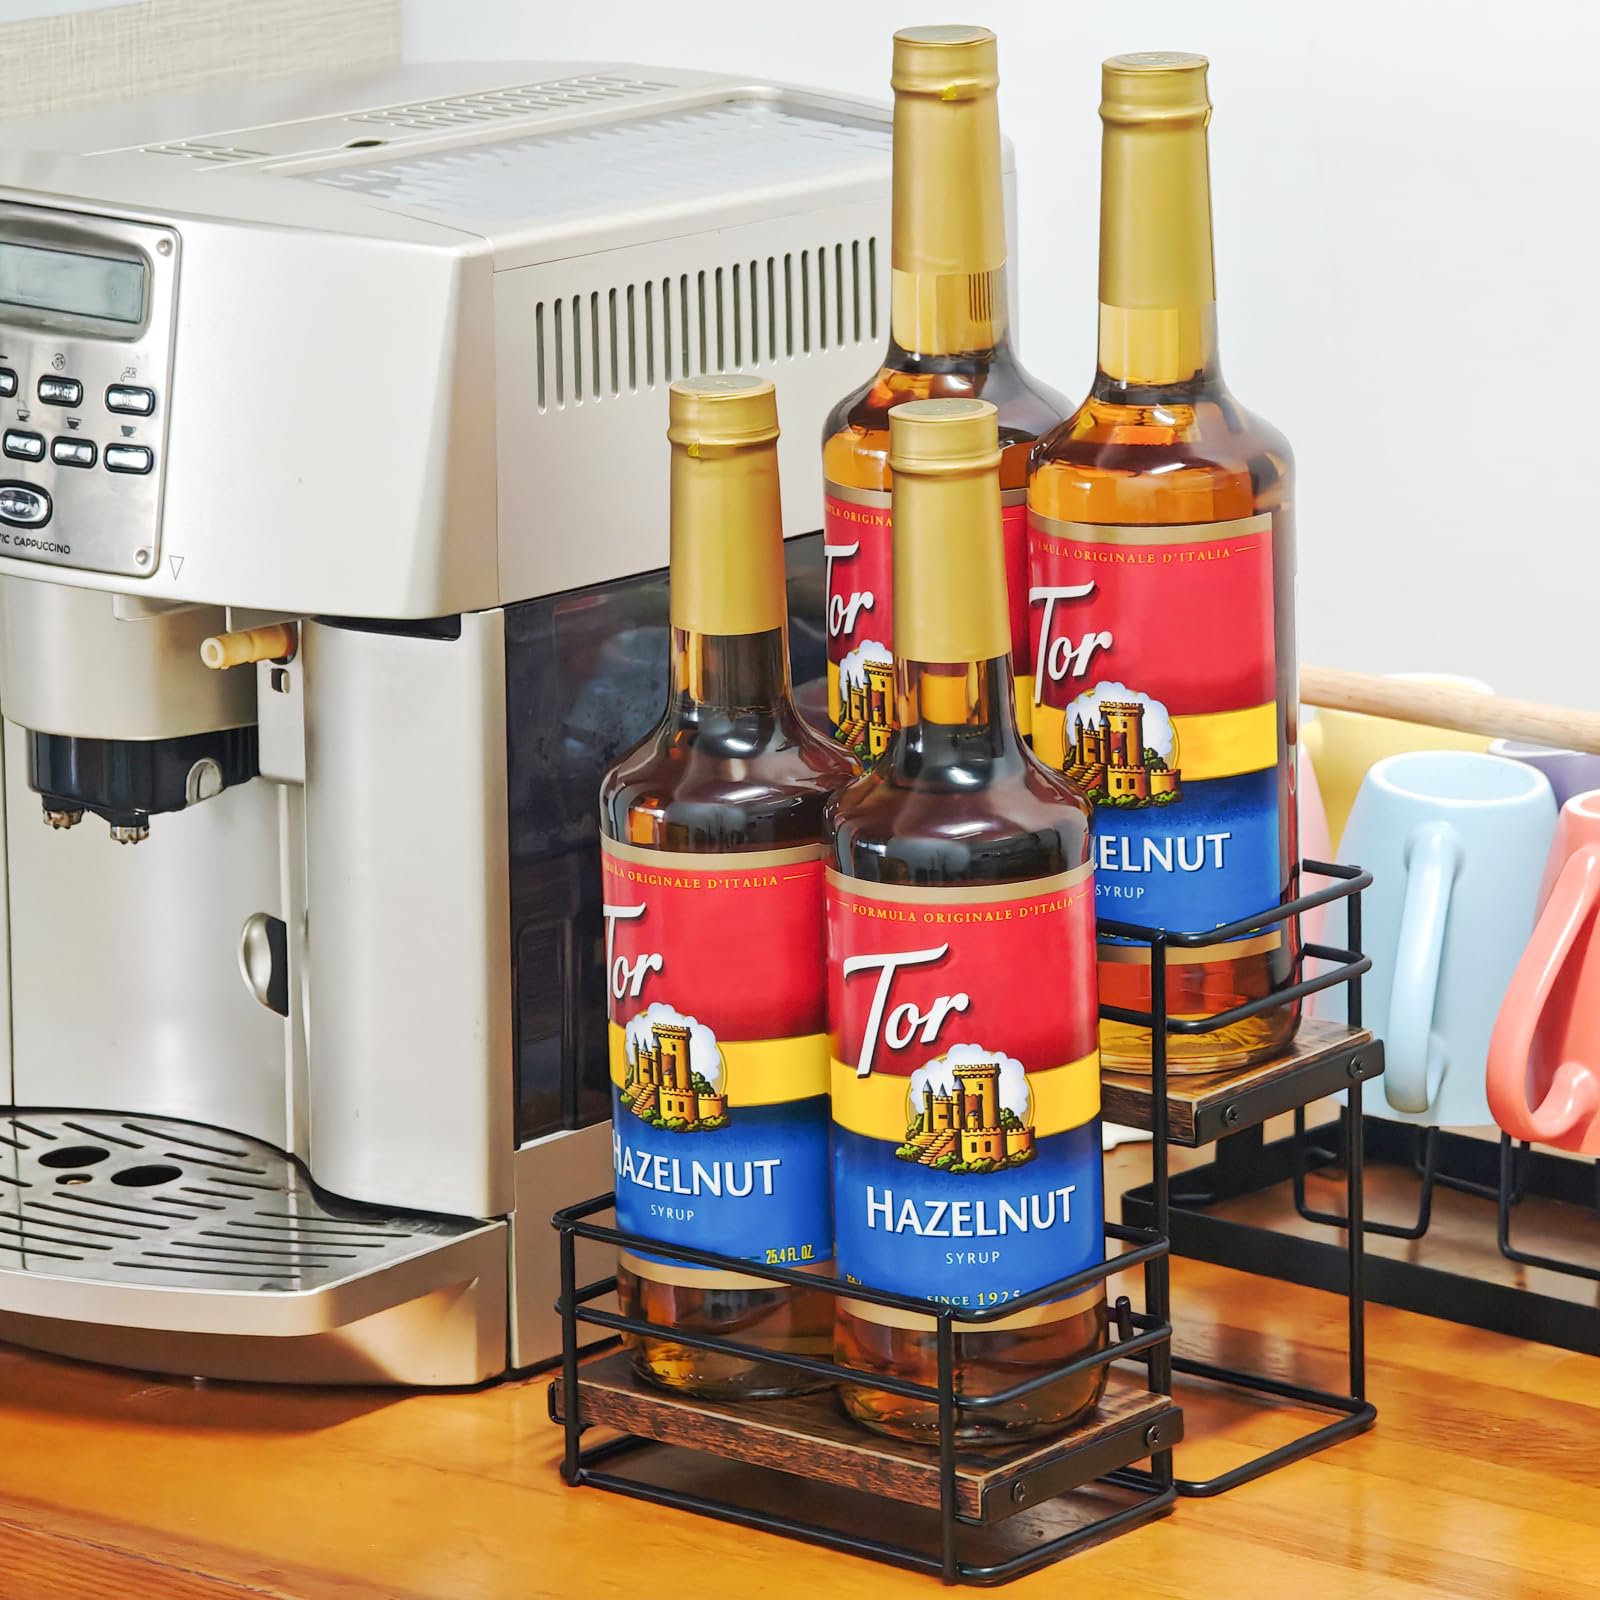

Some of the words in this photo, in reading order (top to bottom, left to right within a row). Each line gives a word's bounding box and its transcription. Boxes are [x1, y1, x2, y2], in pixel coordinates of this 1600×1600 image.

[843, 510, 893, 527] ORIGINA
[13, 535, 71, 554] CAPPUCCINO
[1073, 550, 1155, 564] ORIGINALE
[1162, 548, 1231, 563] D'ITALIA
[1028, 580, 1113, 705] Tor
[1094, 832, 1231, 872] ELNUT
[628, 871, 701, 889] ORIGINALE
[707, 876, 778, 888] D'ITALIA
[1096, 884, 1145, 898] SYRUP
[852, 903, 917, 922] FORMULA
[923, 909, 1013, 923] ORIGINALE
[1019, 896, 1074, 918] D'ITALIA
[603, 902, 663, 1019] Tor
[843, 942, 970, 1078] Tor
[612, 1129, 781, 1197] HAZELNUT
[650, 1204, 695, 1221] SYRUP
[866, 1184, 1076, 1237] HAZELNUT
[766, 1249, 786, 1265] 25.4
[945, 1251, 1000, 1265] SYRUP
[926, 1295, 970, 1306] SINCE
